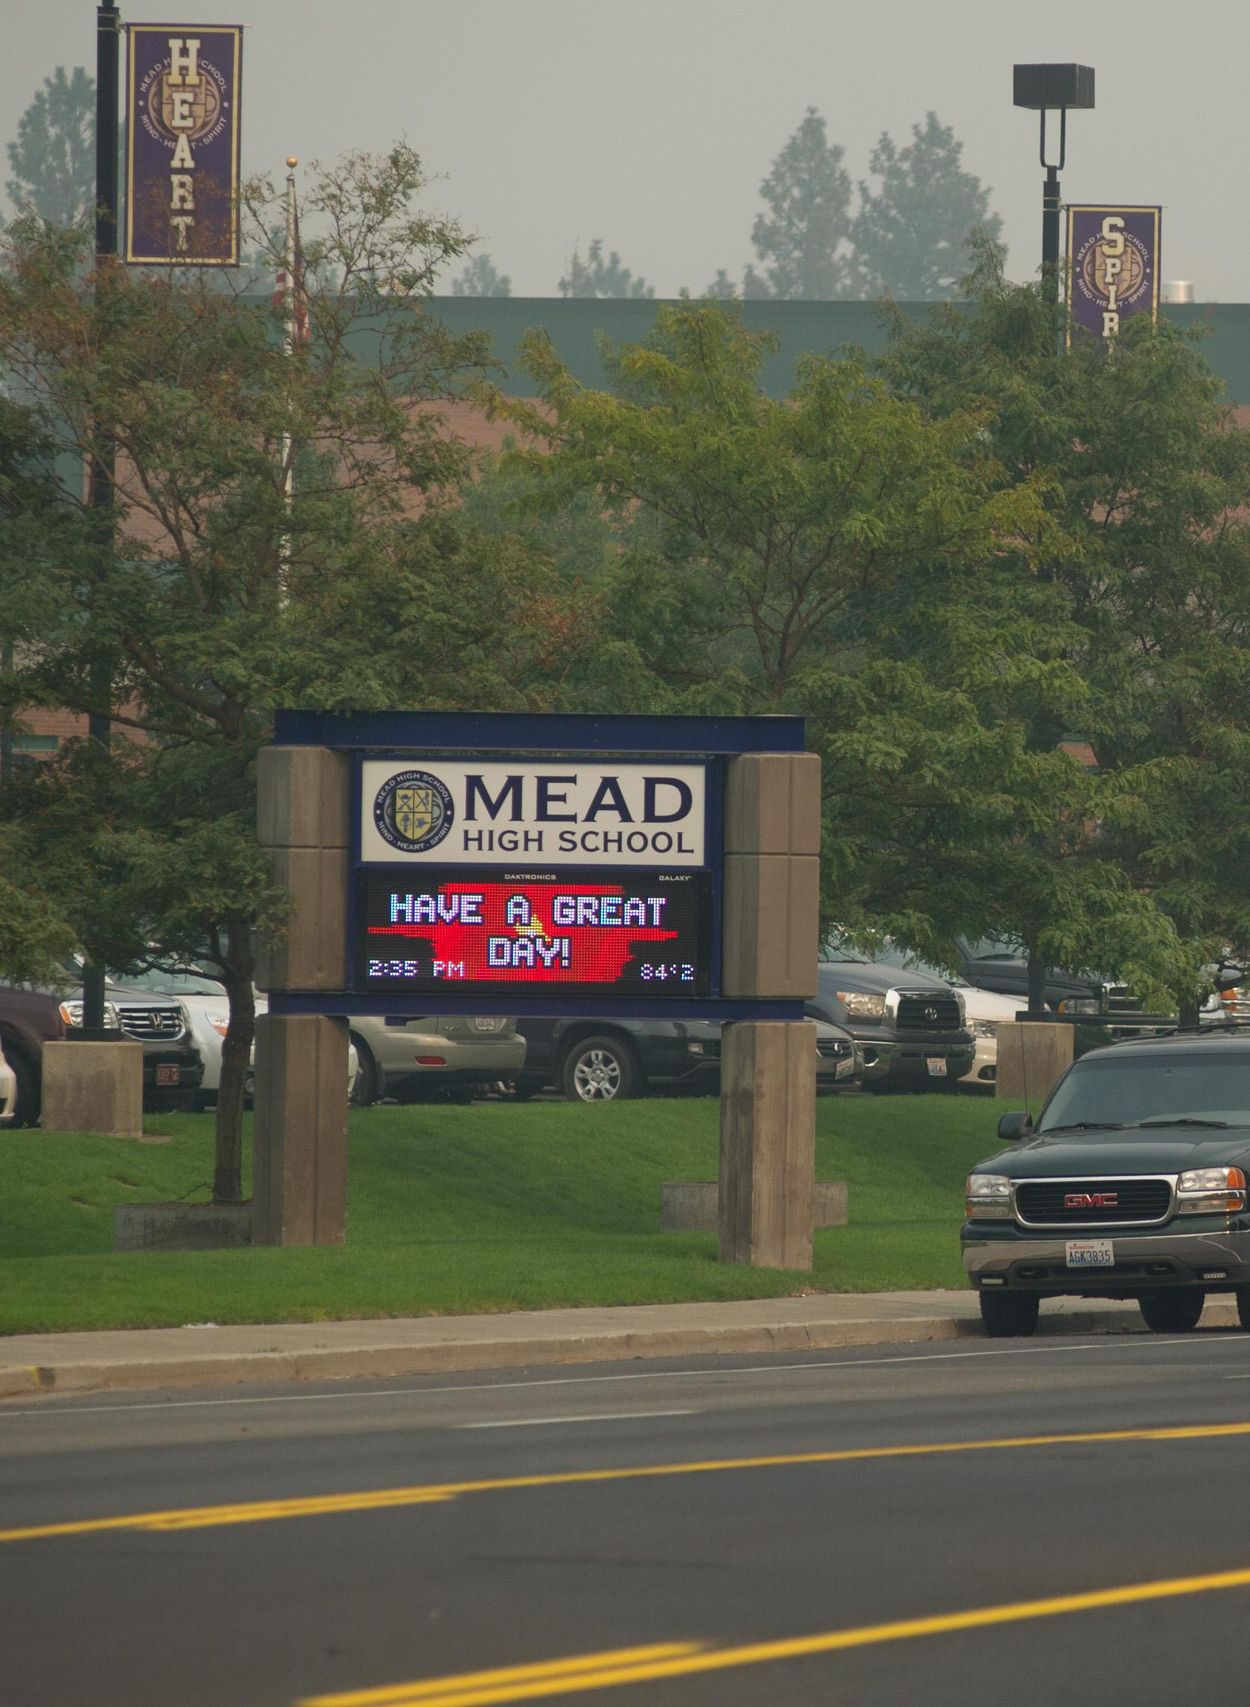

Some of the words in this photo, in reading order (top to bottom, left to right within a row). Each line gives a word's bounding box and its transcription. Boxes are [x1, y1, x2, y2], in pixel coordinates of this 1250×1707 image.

[140, 63, 162, 93] MEAD
[198, 58, 227, 93] CHOOL
[141, 114, 159, 139] MIND
[163, 138, 197, 149] HET
[202, 115, 227, 145] SPIRIT
[168, 38, 201, 250] HEART
[1077, 236, 1096, 261] MEAD
[1077, 278, 1093, 299] MIND
[1096, 299, 1123, 308] HET
[376, 780, 396, 803] MEAD
[396, 772, 420, 782] HIGH
[422, 774, 450, 804] SCHOOL
[462, 774, 693, 824] MEAD
[377, 821, 393, 841] MIND
[397, 841, 425, 850] HEART
[429, 822, 450, 846] SPIRIT
[463, 829, 544, 852] HIGH
[558, 830, 695, 854] SCHOOL
[389, 894, 484, 925] HAVE
[506, 895, 530, 925] A
[553, 896, 667, 927] GREAT
[488, 936, 570, 967] DAY!
[369, 960, 417, 976] 2:35
[433, 961, 464, 977] PM
[1064, 1192, 1119, 1208] GMC
